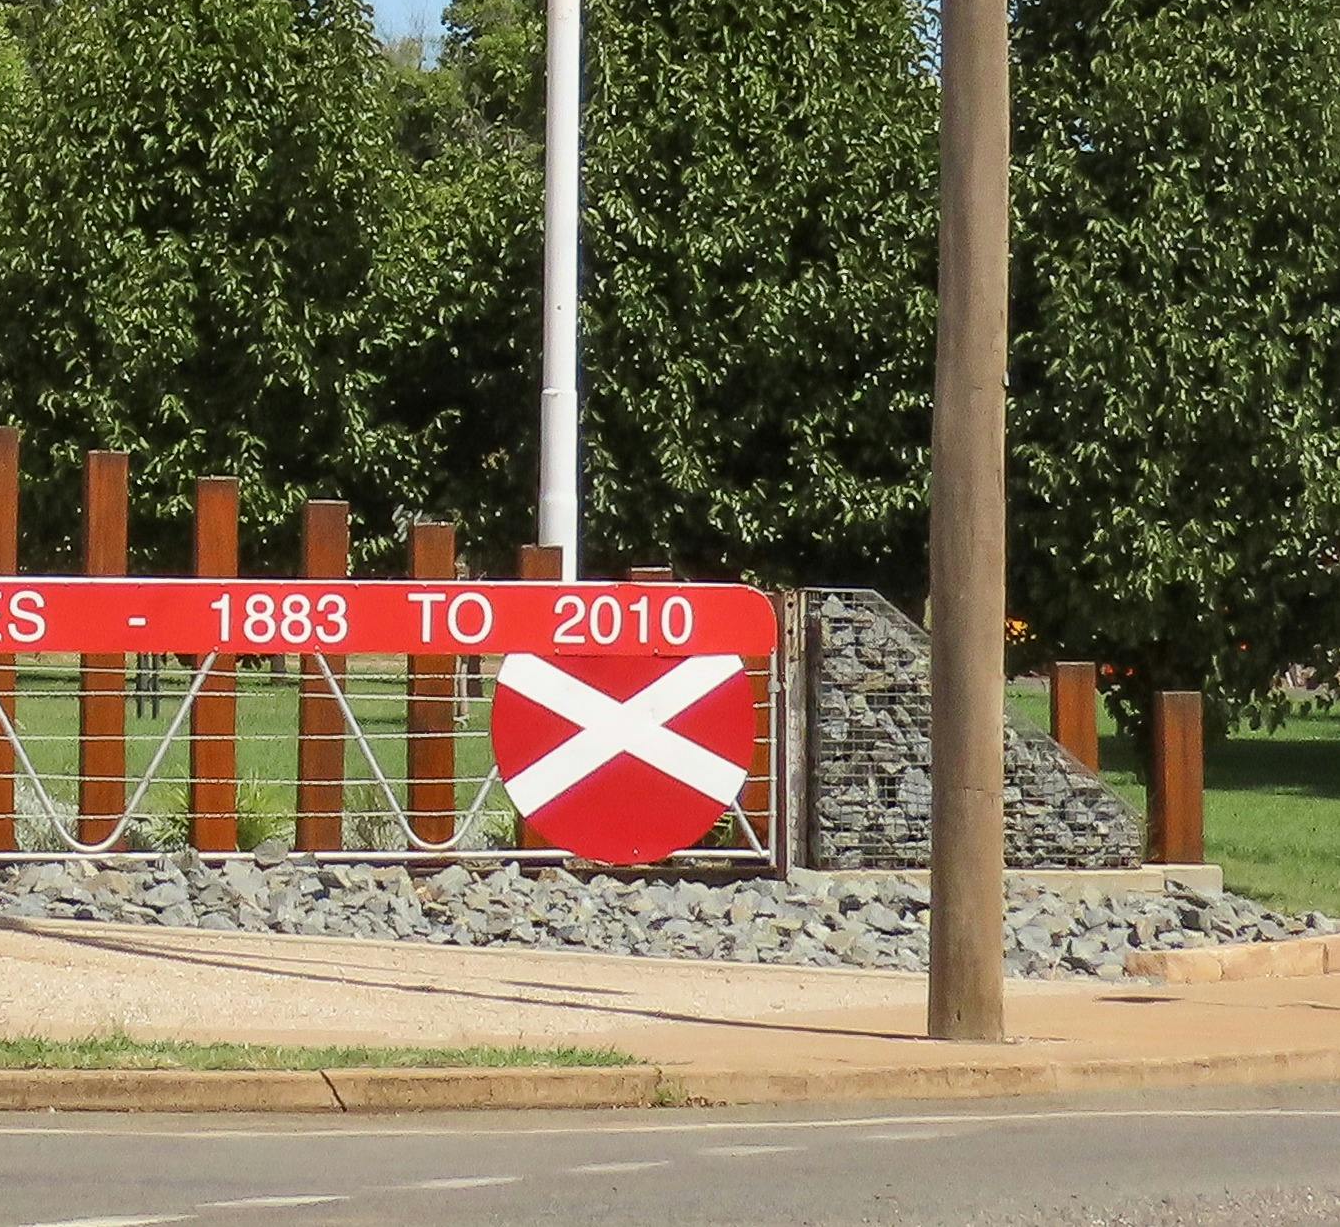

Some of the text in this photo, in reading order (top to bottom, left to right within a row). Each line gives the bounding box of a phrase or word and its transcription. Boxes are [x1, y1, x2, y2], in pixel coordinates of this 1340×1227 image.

[127, 616, 147, 627] -
[209, 592, 349, 644] 1883
[407, 591, 494, 644] TO
[552, 595, 694, 645] 2010
